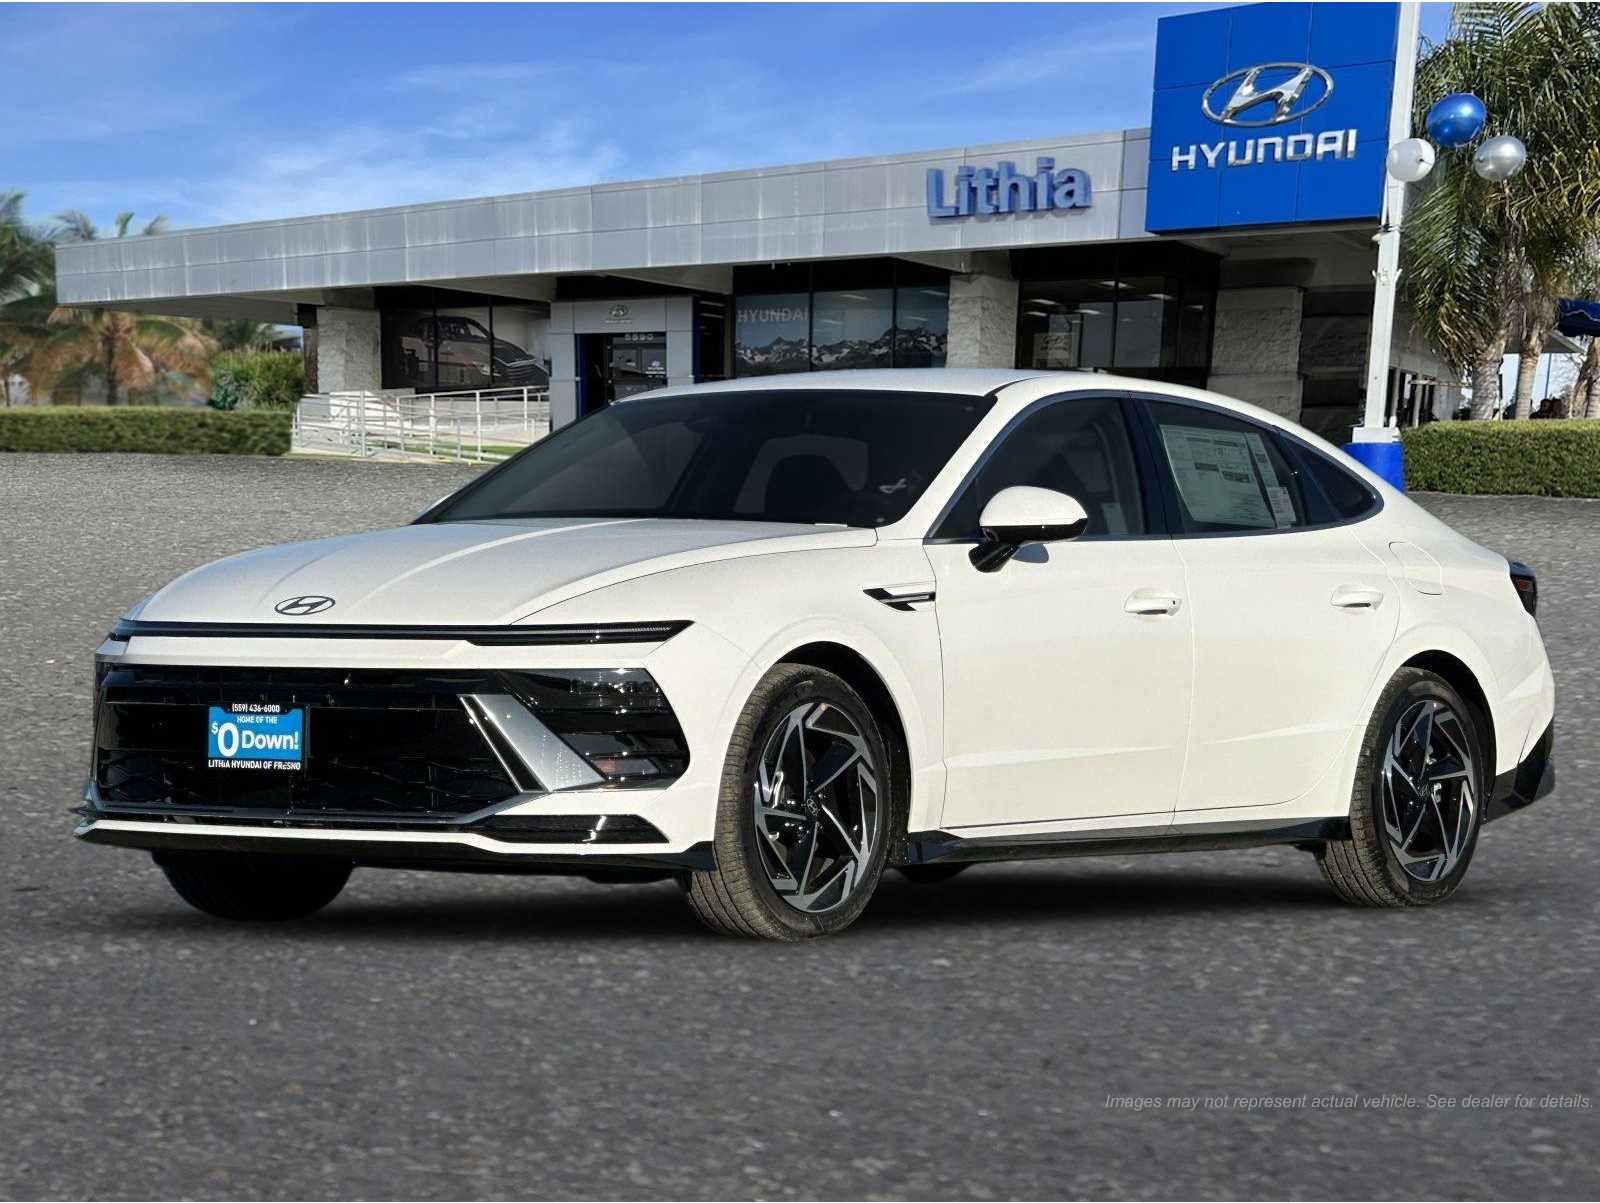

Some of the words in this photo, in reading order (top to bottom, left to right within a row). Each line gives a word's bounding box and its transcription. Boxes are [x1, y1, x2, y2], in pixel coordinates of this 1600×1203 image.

[1171, 128, 1358, 171] HYUNDAI
[926, 156, 1092, 219] Lithia
[736, 307, 809, 322] HYUNDAI
[236, 715, 255, 724] HOME
[255, 716, 264, 724] OF
[265, 716, 278, 724] THE
[241, 729, 299, 750] Down!
[231, 760, 262, 769] HYUNDAI
[263, 761, 272, 769] OF
